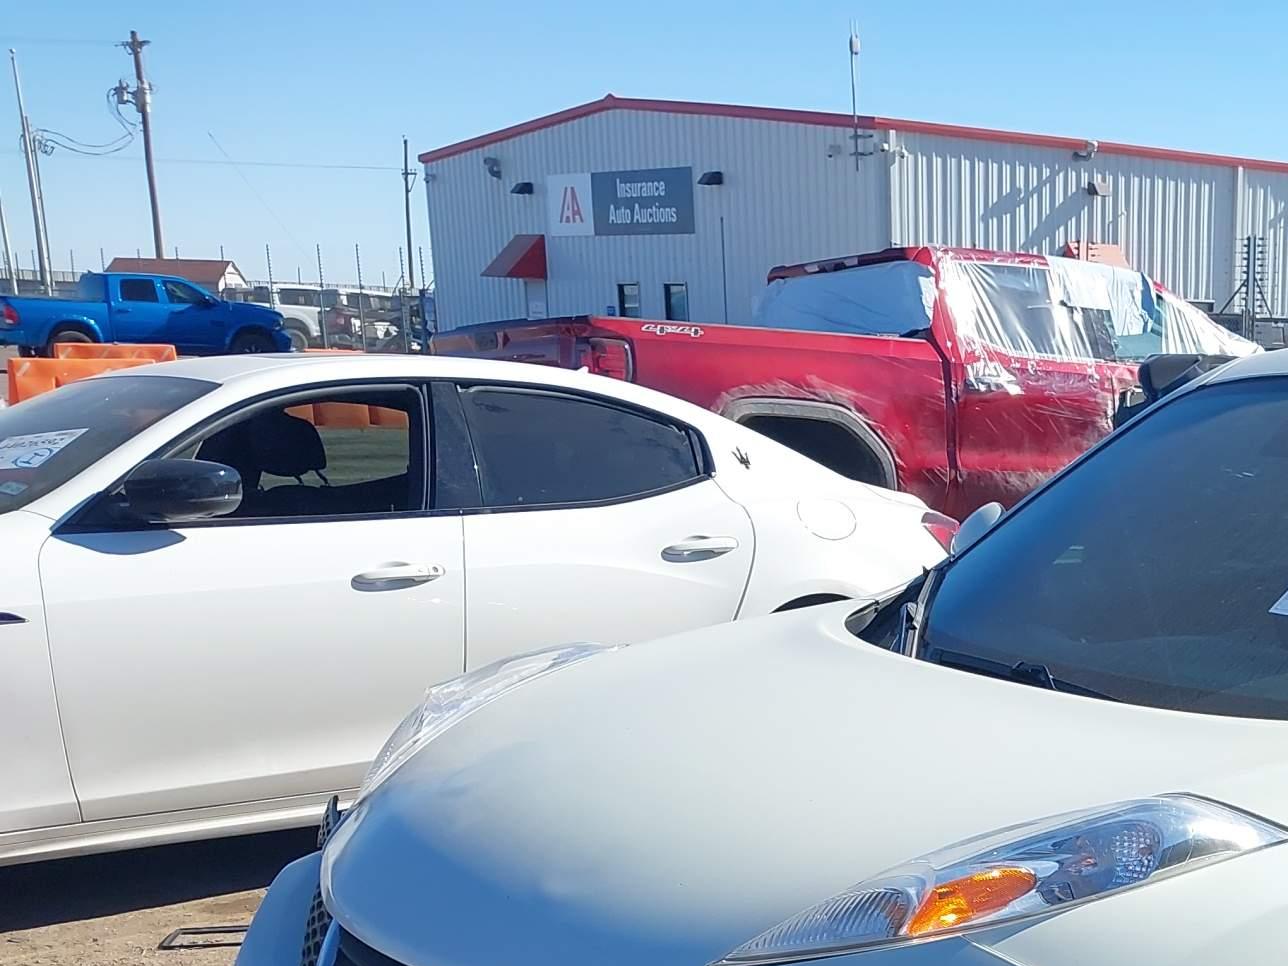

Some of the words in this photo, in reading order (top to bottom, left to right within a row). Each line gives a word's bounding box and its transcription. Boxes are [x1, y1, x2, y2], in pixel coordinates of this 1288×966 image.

[616, 178, 666, 198] Insurance
[609, 204, 631, 225] Auto
[633, 202, 677, 224] Auctions
